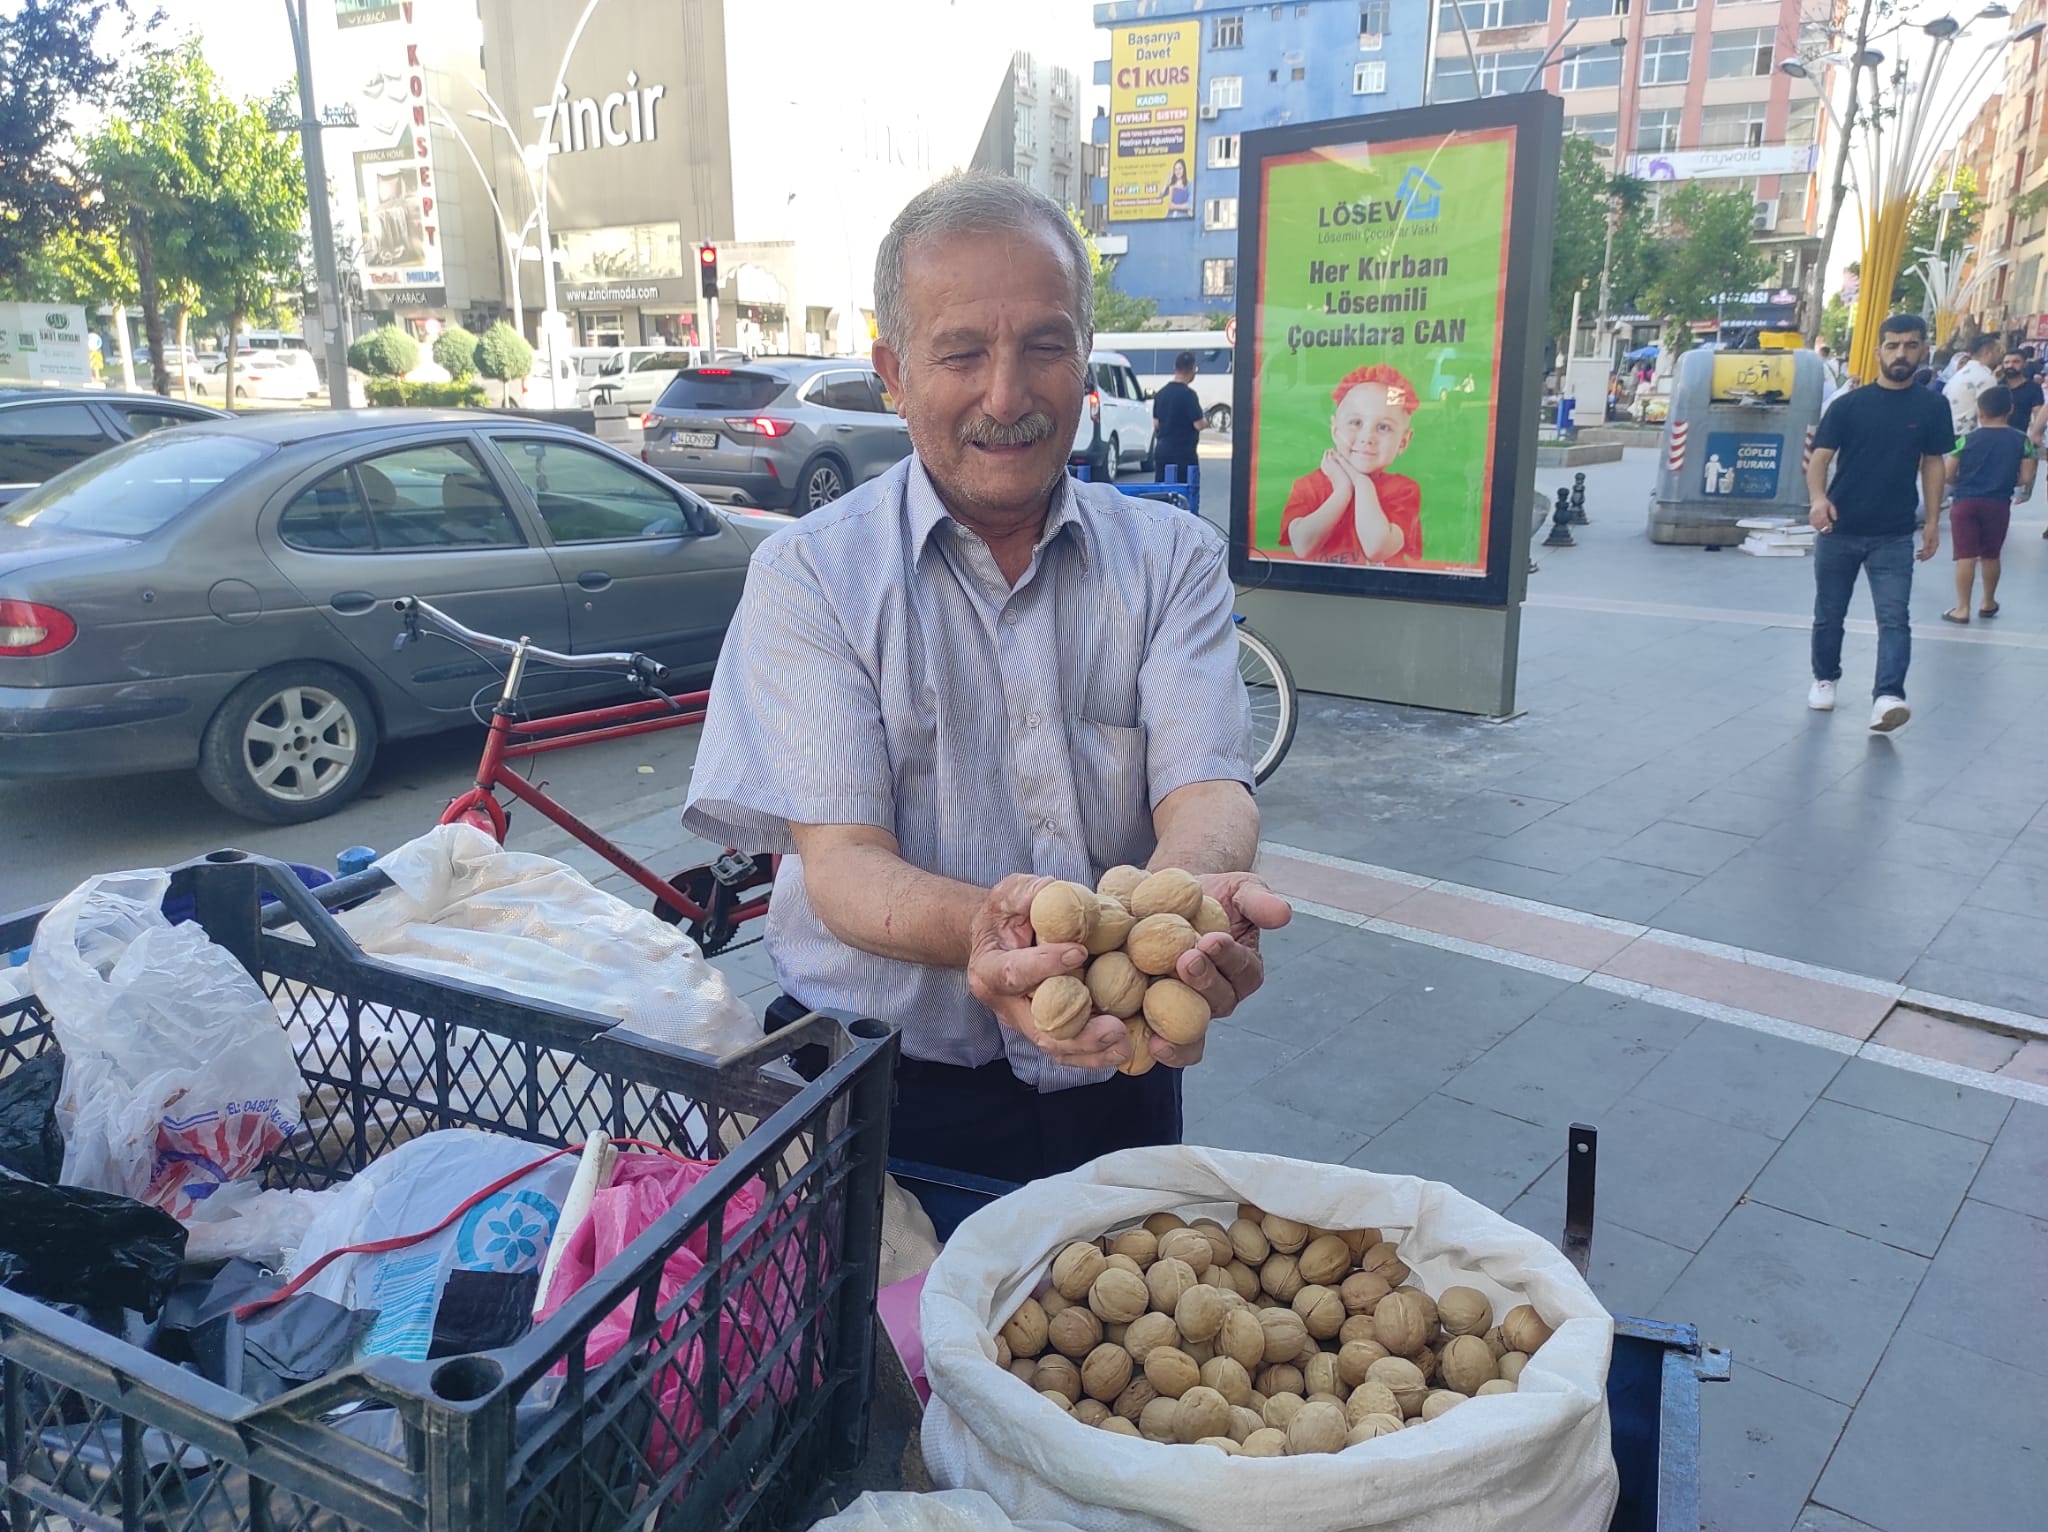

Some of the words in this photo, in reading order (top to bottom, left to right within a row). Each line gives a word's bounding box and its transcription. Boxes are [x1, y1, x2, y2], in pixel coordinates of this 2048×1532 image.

[1128, 31, 1181, 47] Başarıya
[1136, 47, 1171, 61] Davet
[1117, 66, 1141, 90] C1
[1145, 65, 1190, 87] KURS
[533, 69, 666, 155] zincir
[406, 44, 436, 246] KONSEPT
[1700, 150, 1761, 166] myworld
[1318, 199, 1402, 228] LÖSEV
[1363, 225, 1408, 243] Çocukar
[406, 271, 440, 284] PHILIPS
[1309, 260, 1350, 284] Her
[1358, 254, 1448, 281] Kurban
[396, 292, 427, 304] KARACA
[566, 285, 659, 302] www.zincirmoda.com
[1325, 286, 1428, 315] Lösemili
[1287, 322, 1405, 355] Çocuklara
[1414, 318, 1466, 345] CAN
[1736, 460, 1777, 470] BURAYA
